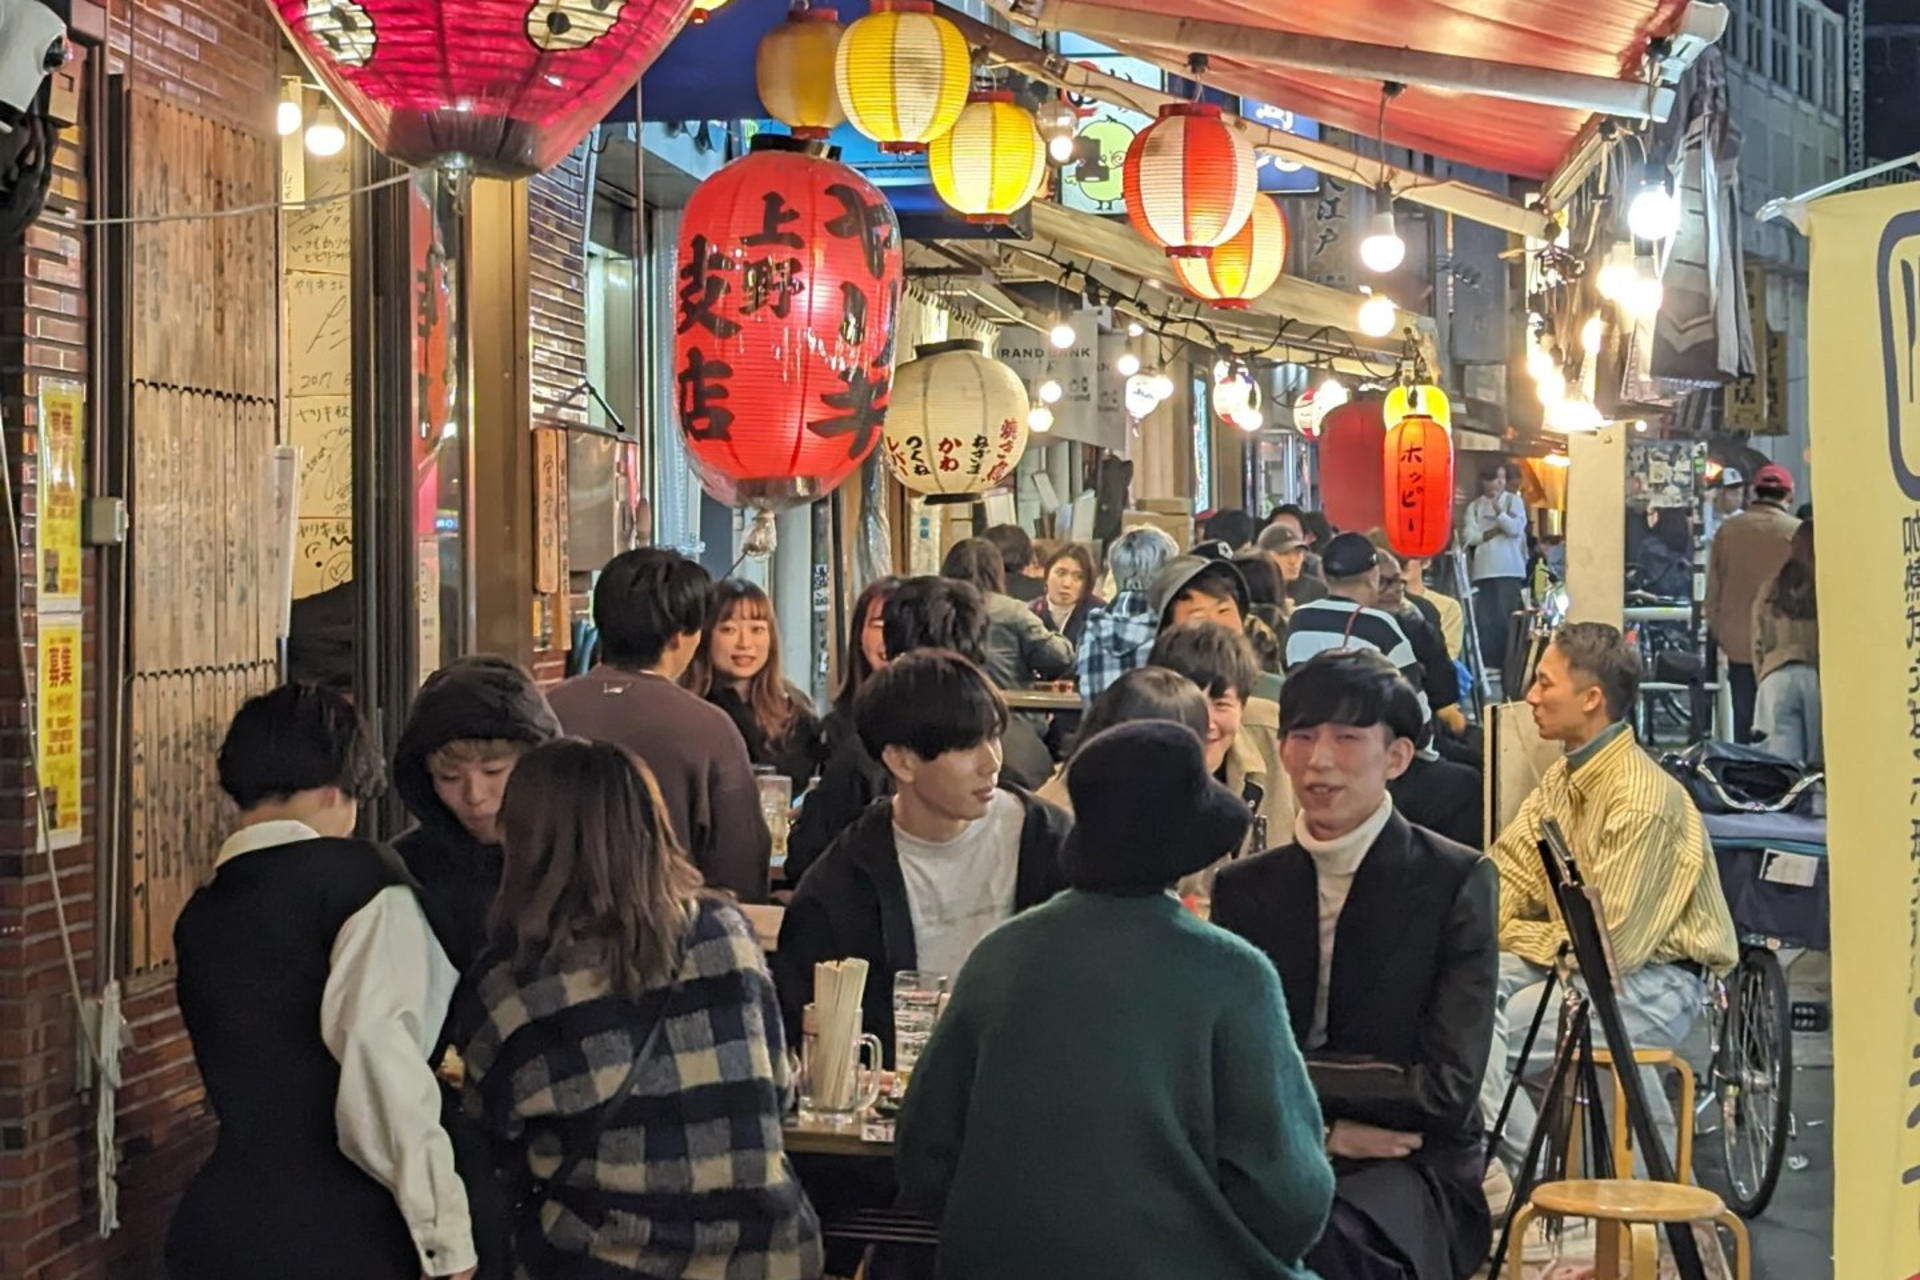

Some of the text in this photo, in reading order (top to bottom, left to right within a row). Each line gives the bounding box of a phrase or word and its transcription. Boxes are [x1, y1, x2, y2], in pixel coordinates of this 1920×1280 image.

[740, 190, 806, 319] 上野
[1313, 178, 1346, 256] 江戸
[677, 234, 743, 443] 支店
[807, 183, 899, 461] ヤリキ
[885, 436, 909, 477] レバー
[906, 435, 931, 476] つくね
[938, 437, 962, 472] かわ
[966, 434, 991, 475] ねぎま
[1400, 445, 1424, 532] ホッピー
